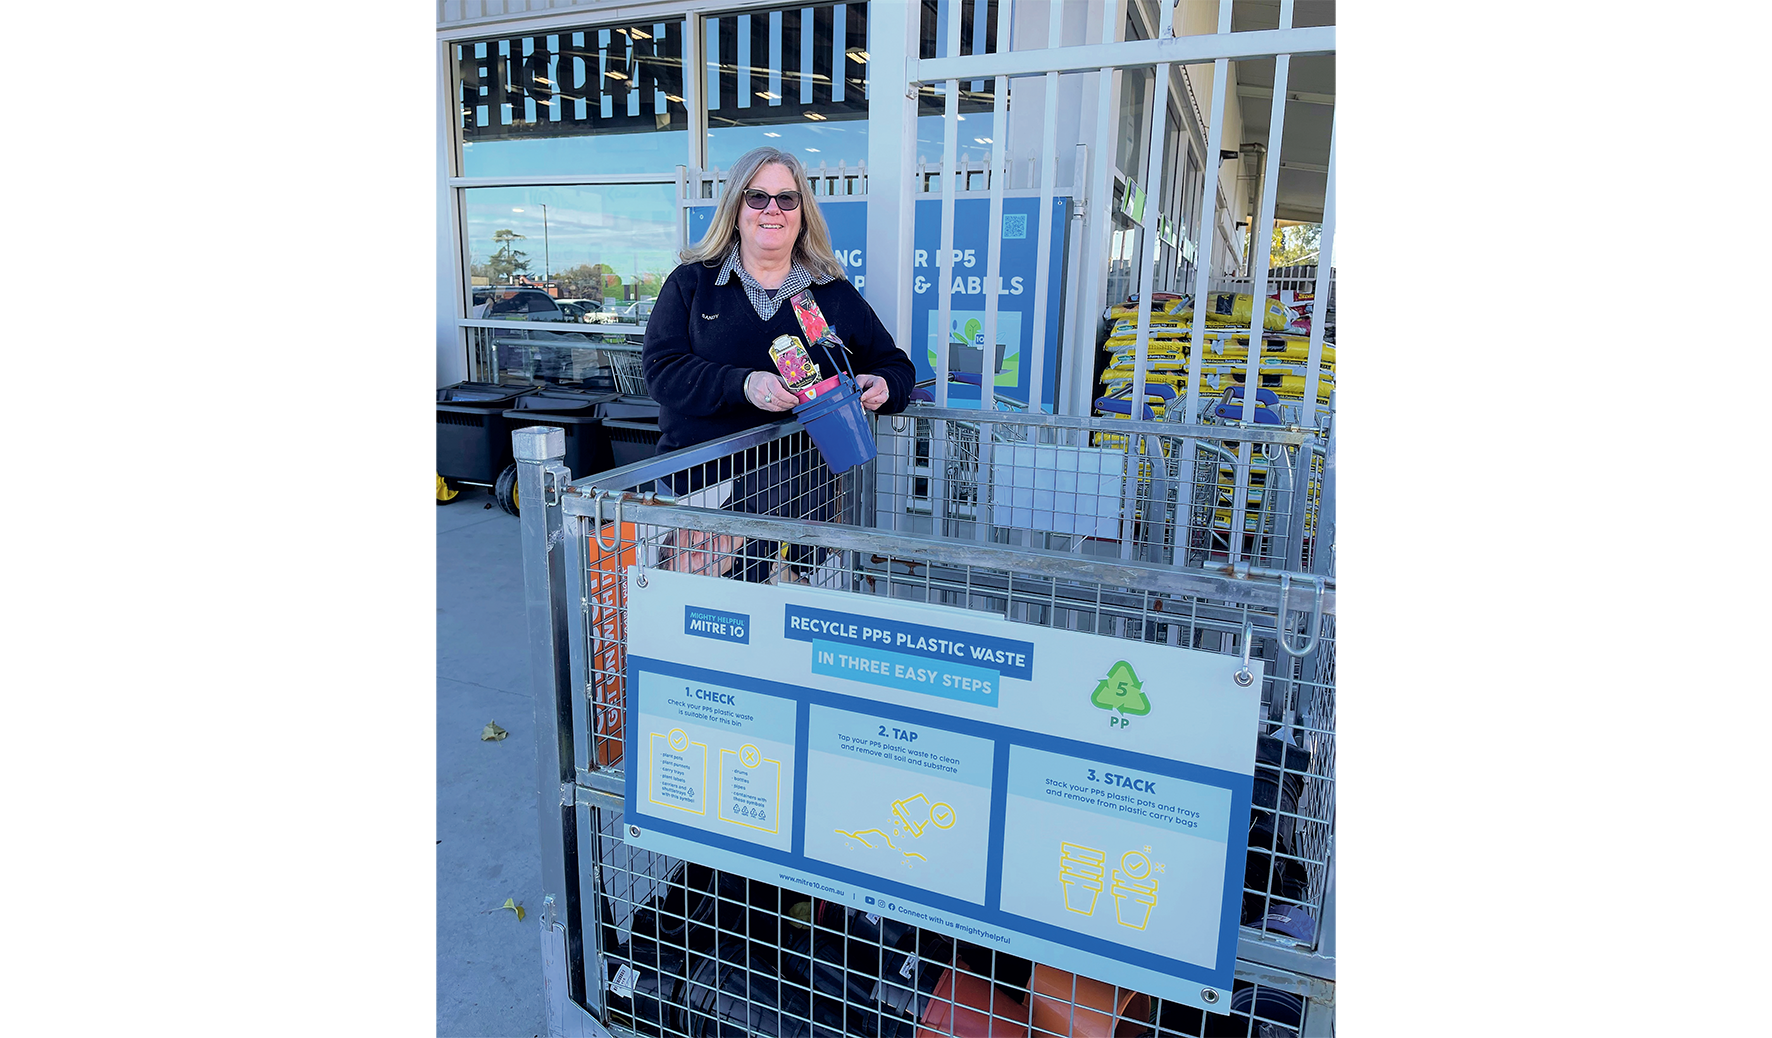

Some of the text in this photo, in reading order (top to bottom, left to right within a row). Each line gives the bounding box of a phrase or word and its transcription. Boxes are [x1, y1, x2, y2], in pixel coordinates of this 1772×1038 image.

[936, 250, 976, 268] P5
[914, 276, 1024, 295] & ABLS
[689, 611, 745, 626] MIGHTY HELPFUL
[689, 619, 745, 638] MITRE 10
[790, 615, 1026, 668] RECYCLE PP5 PLASTIC WASTE
[817, 650, 993, 695] IN THREE EASY STEPS
[685, 686, 736, 706] 1. CHECK
[1115, 681, 1129, 697] 5
[667, 698, 754, 722] Check your PP5 plastic waste
[684, 710, 708, 721] suitable
[708, 714, 718, 722] for
[719, 717, 731, 725] this
[731, 719, 742, 727] bin
[878, 725, 919, 743] 2. TAP
[837, 733, 960, 766] Tap your PP5 plastic waste to clean
[840, 742, 958, 774] and remove all soil and substrate
[1086, 768, 1156, 795] 3. STACK
[1045, 778, 1200, 819] Stack your PP5 plastic pots and trays
[1045, 787, 1198, 829] and remove from plastic carry bags
[778, 872, 845, 897] www.mitre10.com.au
[897, 905, 1011, 945] Connect with us #mightyhelpful
